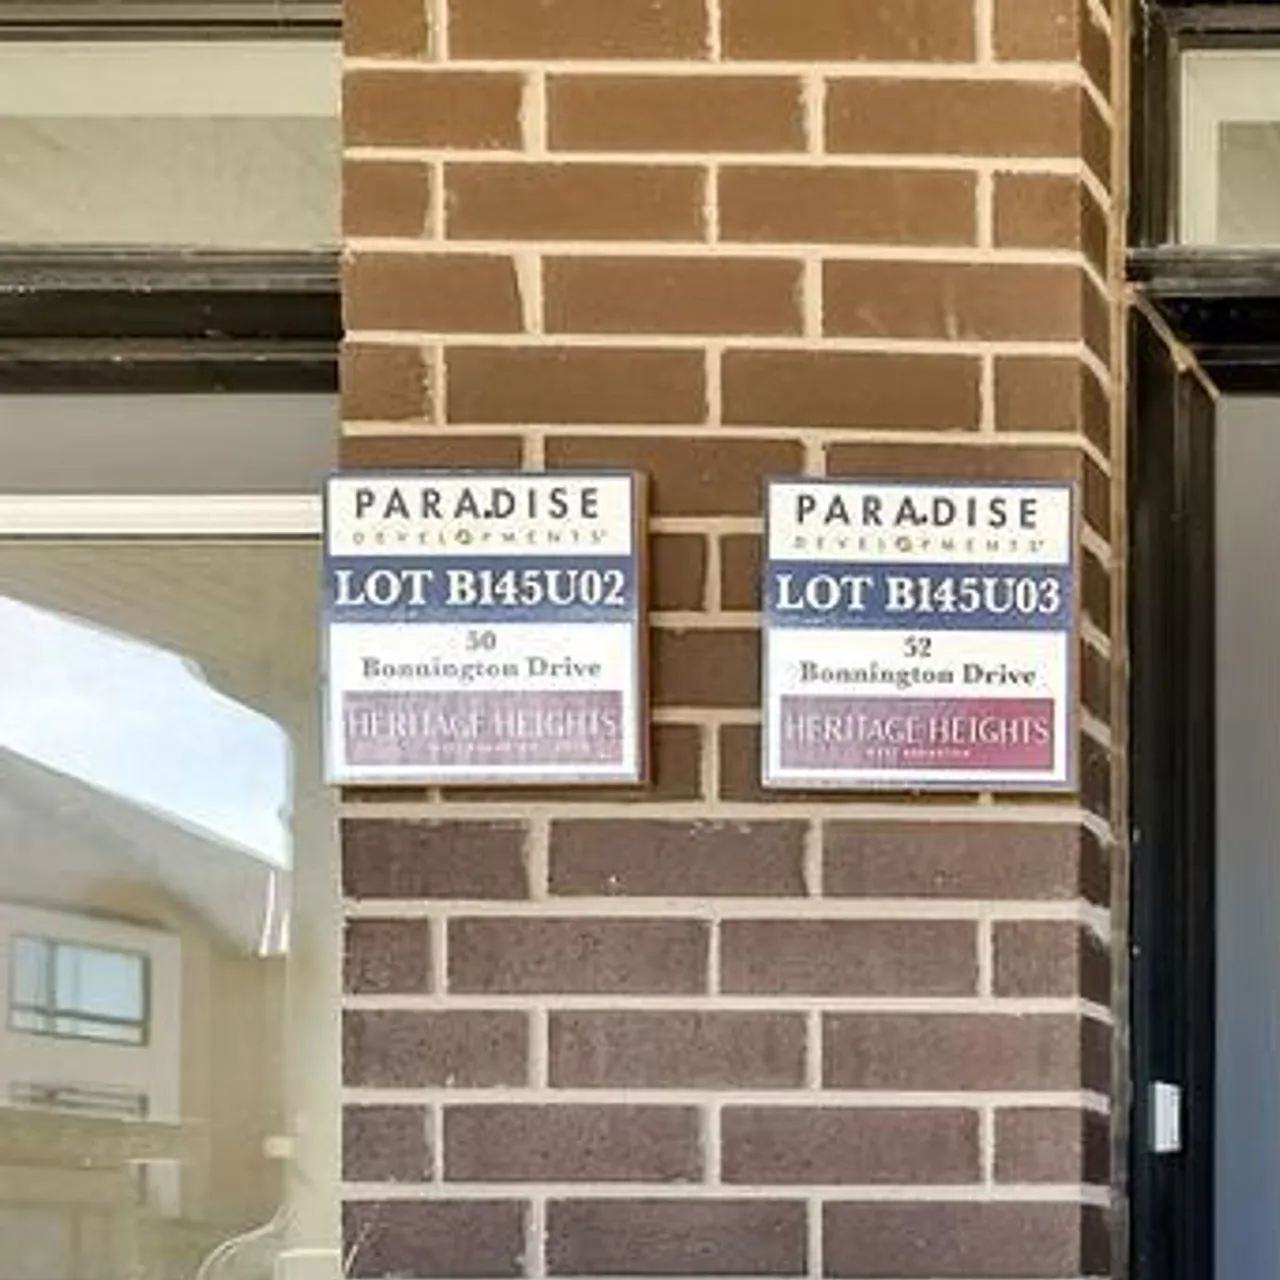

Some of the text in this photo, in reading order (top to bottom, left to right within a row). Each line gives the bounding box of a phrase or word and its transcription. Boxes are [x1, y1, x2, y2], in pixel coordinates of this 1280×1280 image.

[355, 487, 599, 519] PARADISE
[797, 495, 1038, 528] PARADISE
[333, 569, 625, 606] LOT B145U02
[776, 574, 1061, 613] LOT B145U03
[904, 637, 932, 658] 52
[361, 656, 602, 681] Bonnington Drive
[800, 661, 1036, 687] Bonnington Drive
[784, 712, 1049, 745] HERITAGE HEIGHTS
